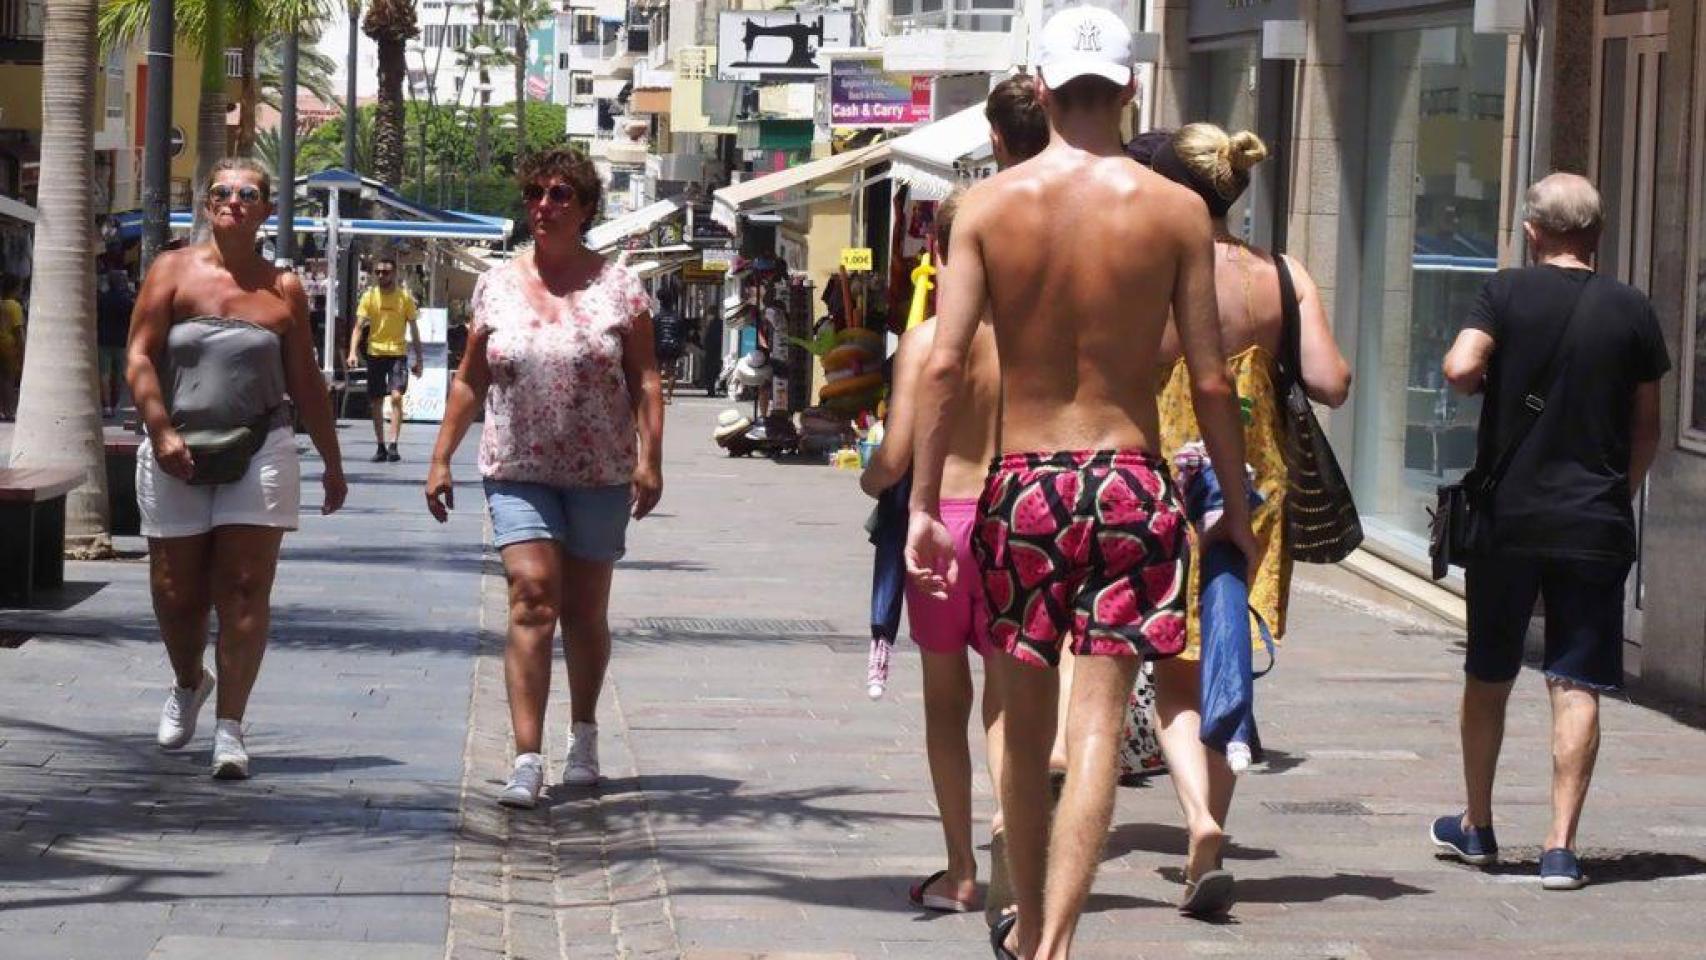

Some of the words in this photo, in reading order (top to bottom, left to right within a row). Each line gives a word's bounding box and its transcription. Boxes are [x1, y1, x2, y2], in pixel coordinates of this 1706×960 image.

[832, 102, 859, 118] Cash
[862, 102, 871, 117] &
[872, 102, 904, 121] Carry
